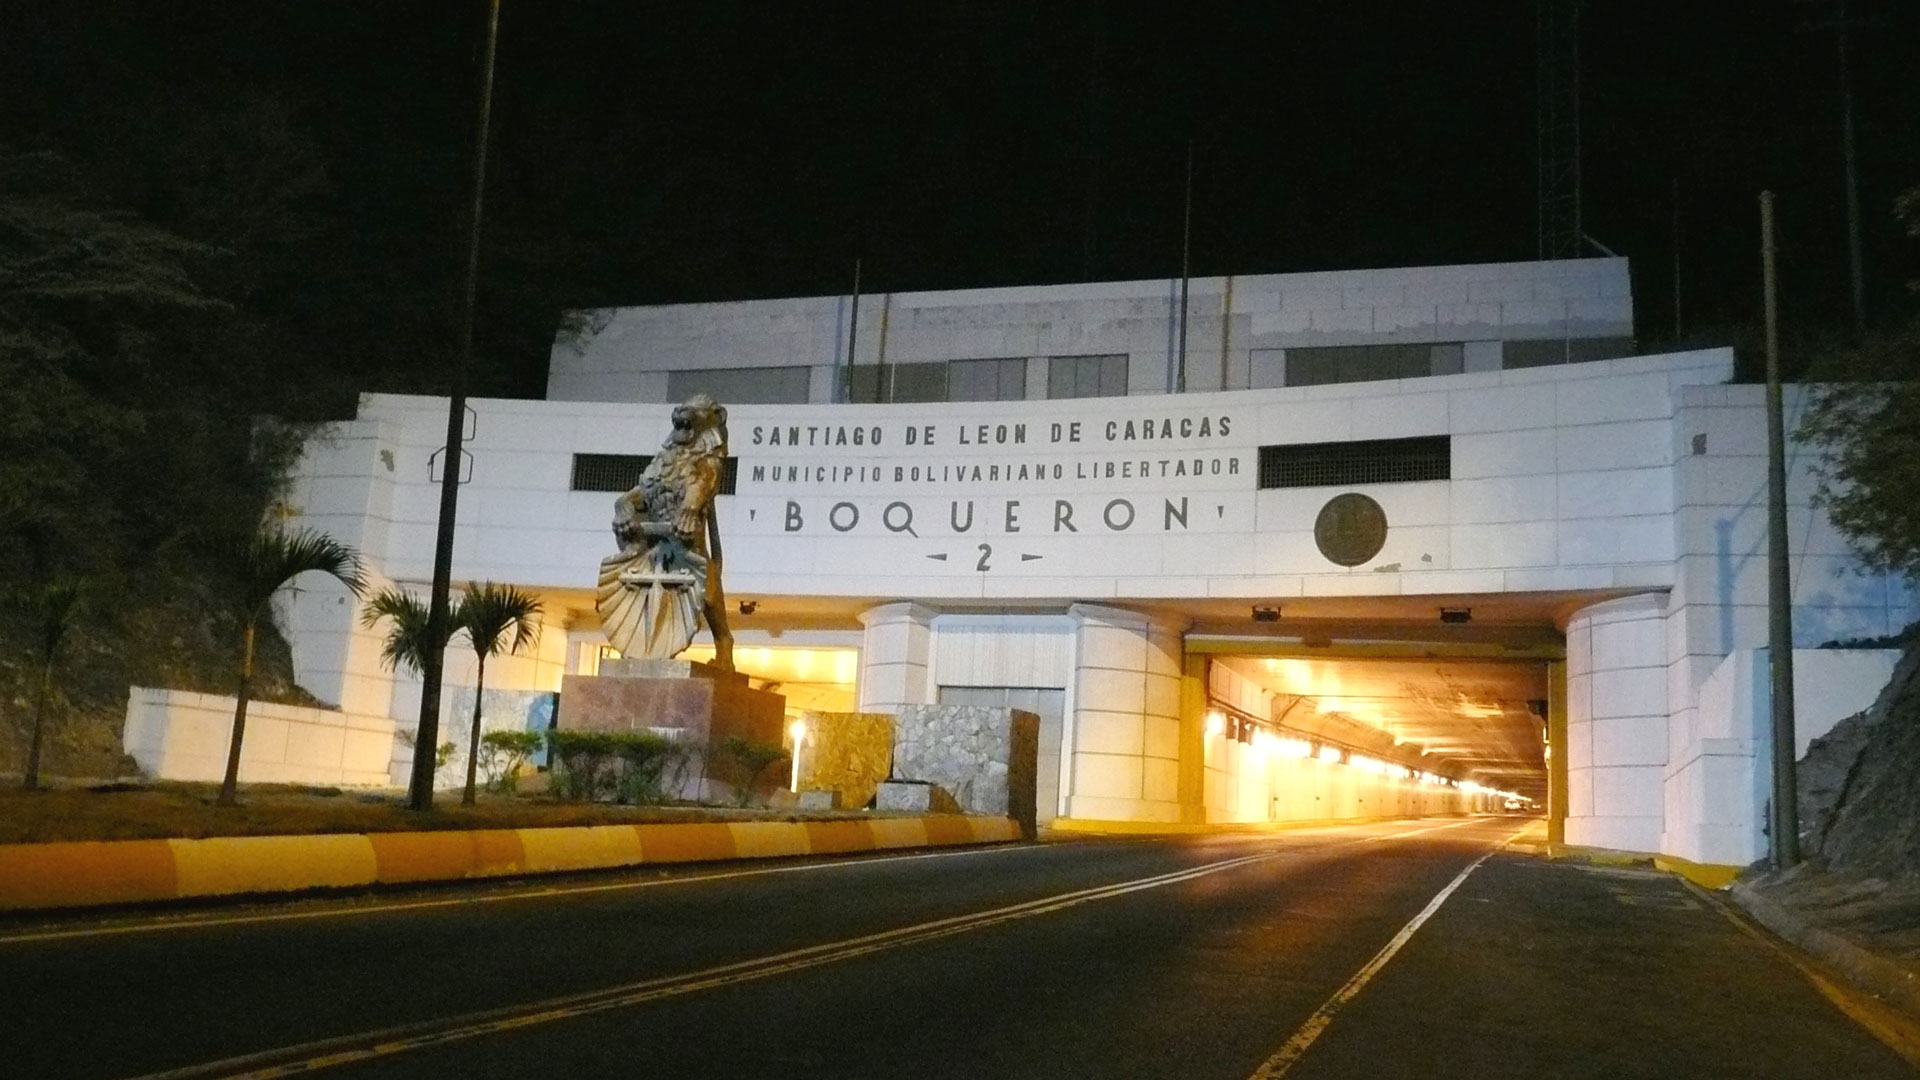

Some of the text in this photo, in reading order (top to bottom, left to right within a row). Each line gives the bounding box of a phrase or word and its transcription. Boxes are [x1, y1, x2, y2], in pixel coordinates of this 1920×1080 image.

[752, 416, 1232, 446] SANTIAGO DE LEON DE CARACAS
[752, 457, 1241, 483] MUNICIPIO BOLIVARIANO LIBERTADOR
[784, 496, 1190, 538] BOQUERON
[976, 543, 994, 573] 2
